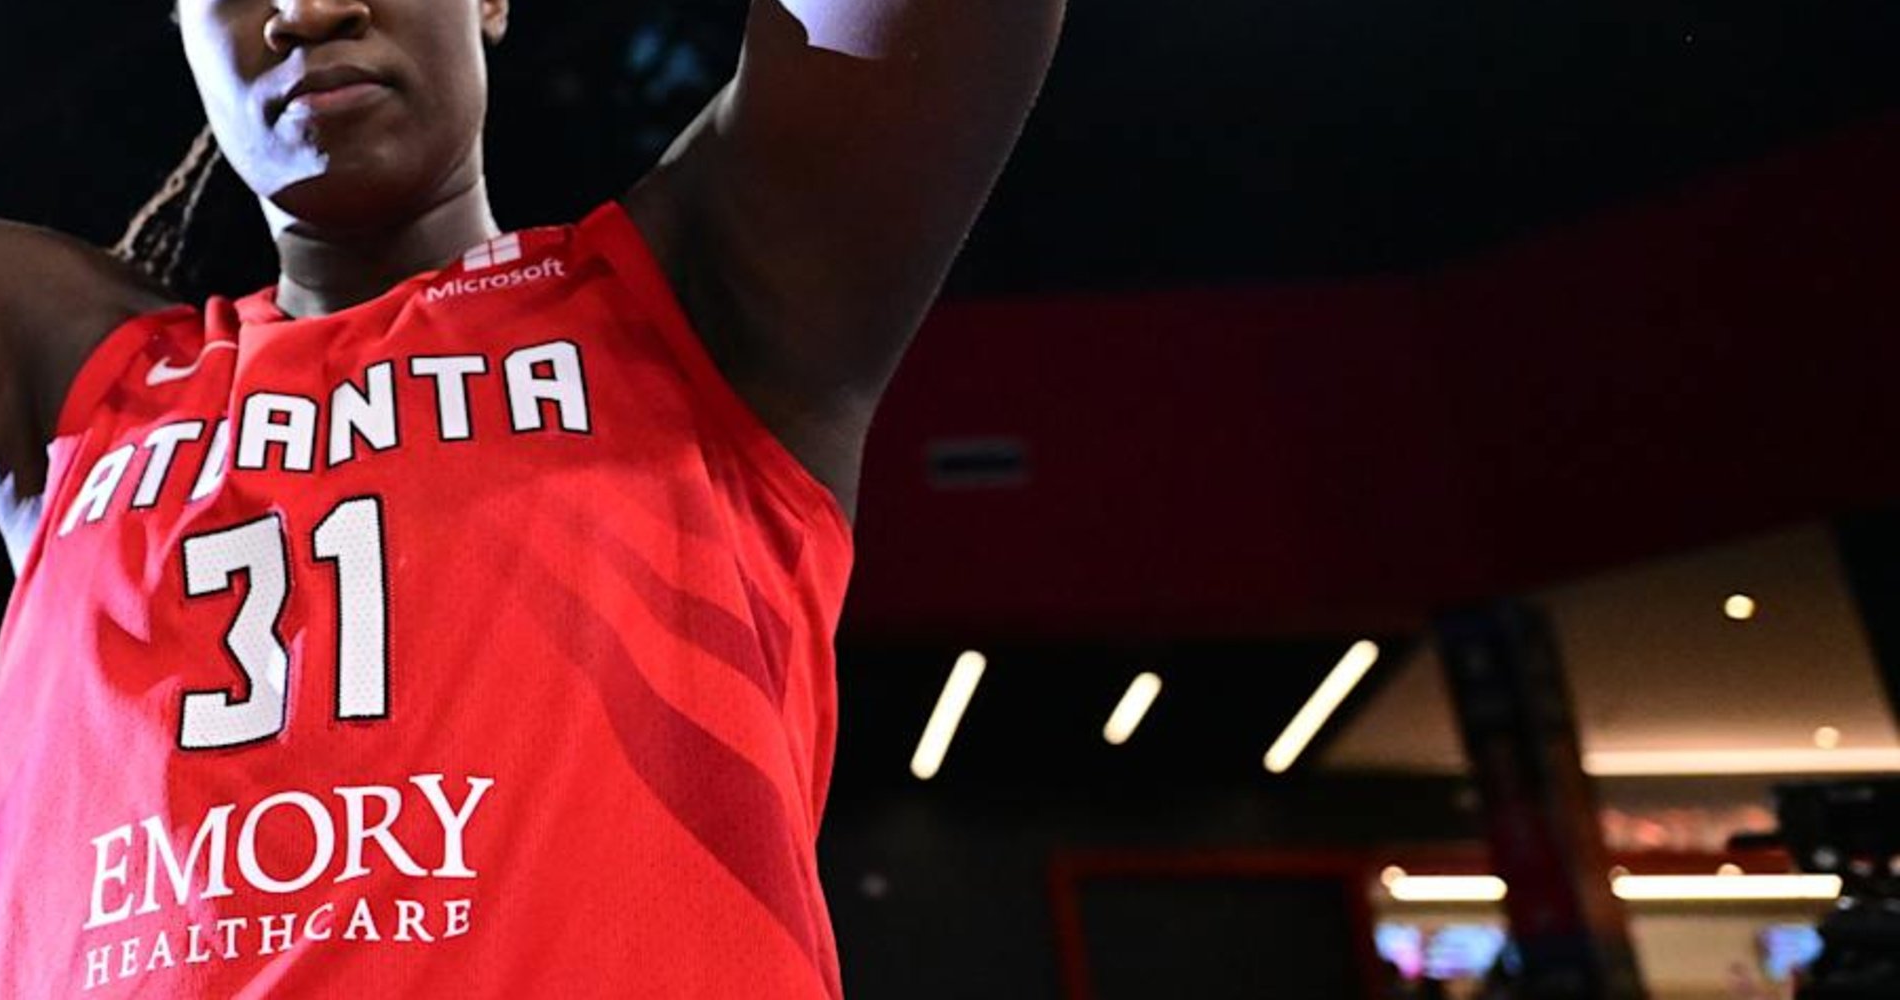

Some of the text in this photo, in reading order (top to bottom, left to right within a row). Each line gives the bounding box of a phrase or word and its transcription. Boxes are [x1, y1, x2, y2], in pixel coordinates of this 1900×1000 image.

[425, 257, 566, 302] Microsoft
[56, 339, 592, 538] ATLANTA
[176, 493, 390, 752] 31
[82, 773, 495, 931] EMORY
[82, 898, 473, 990] HEALTHCARE
